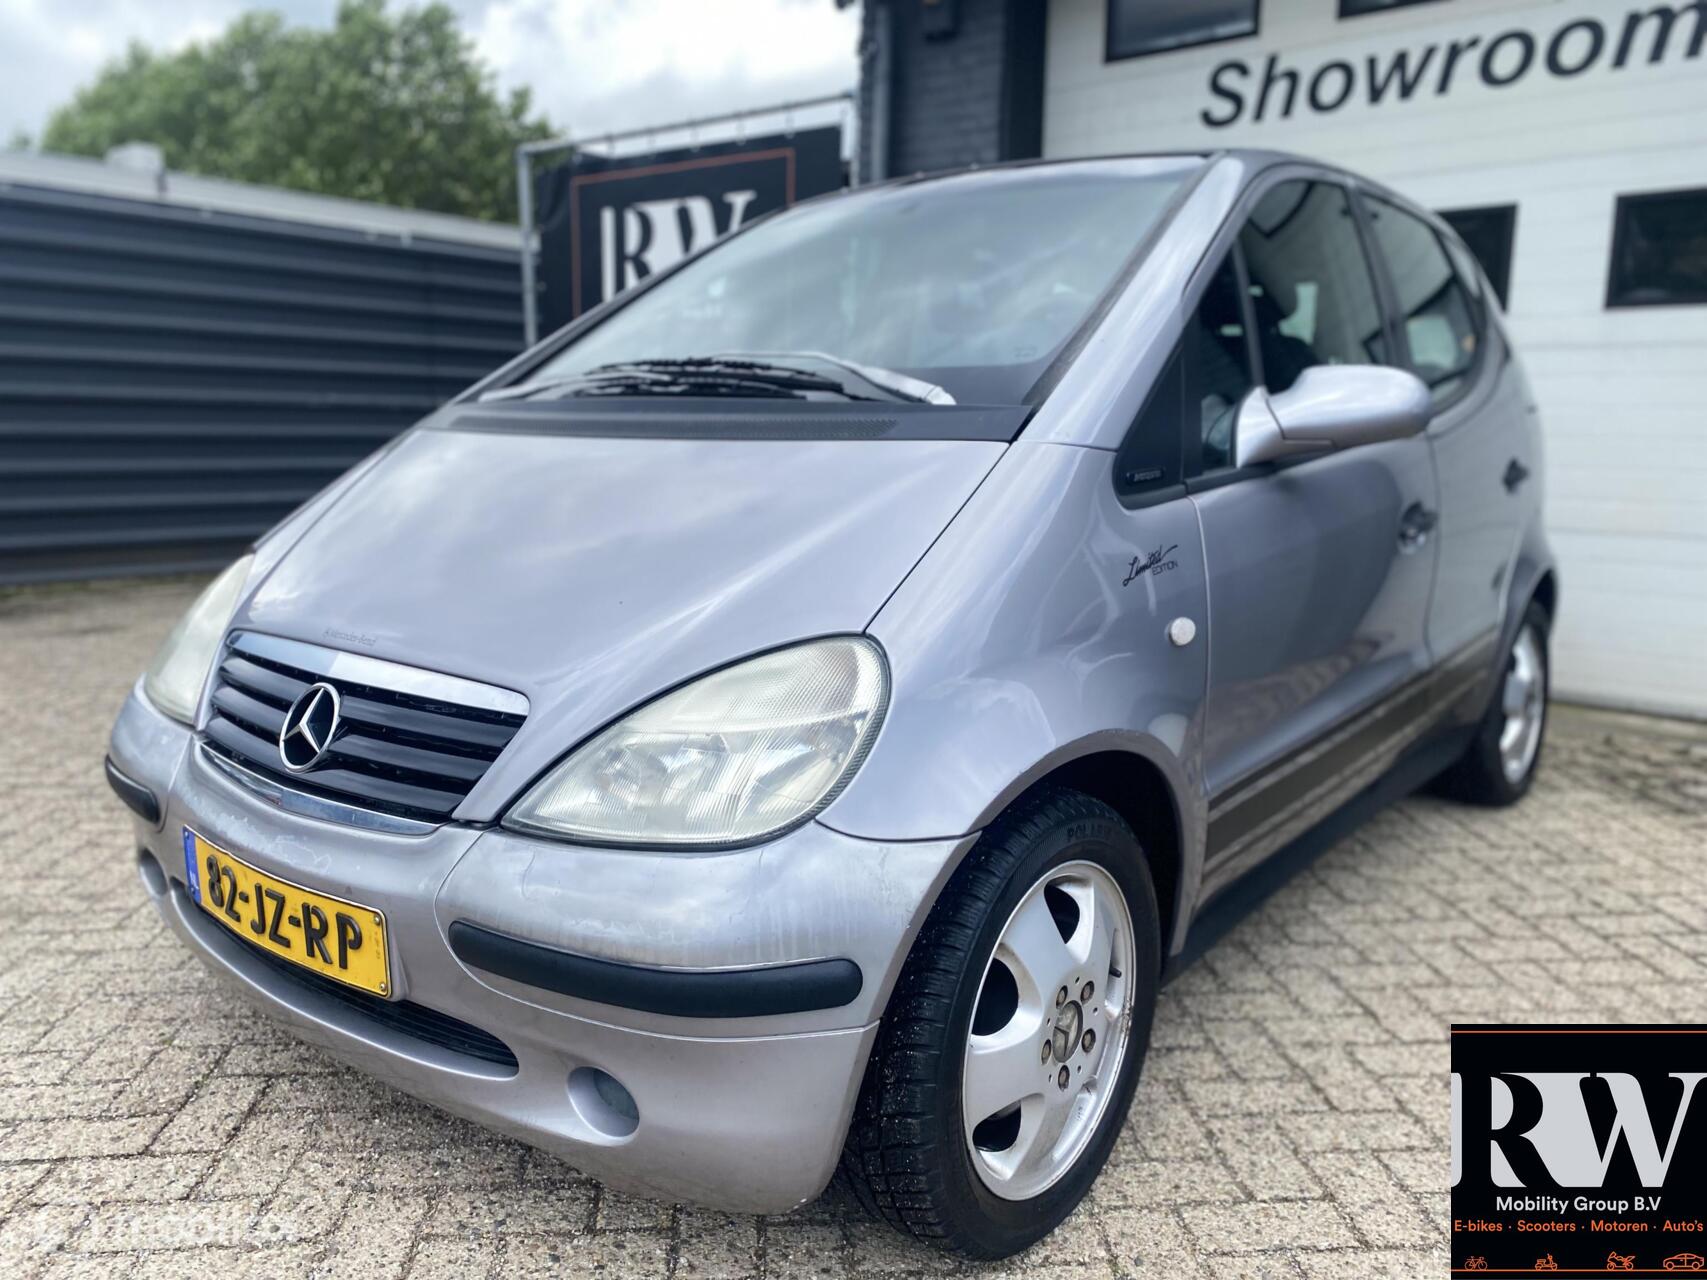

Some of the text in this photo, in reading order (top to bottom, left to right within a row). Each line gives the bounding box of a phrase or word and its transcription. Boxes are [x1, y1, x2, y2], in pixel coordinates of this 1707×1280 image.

[1201, 0, 1707, 128] Showroom
[1122, 544, 1179, 587] Limited
[1152, 560, 1179, 576] EDITION
[206, 855, 362, 970] 82-JZ-RP
